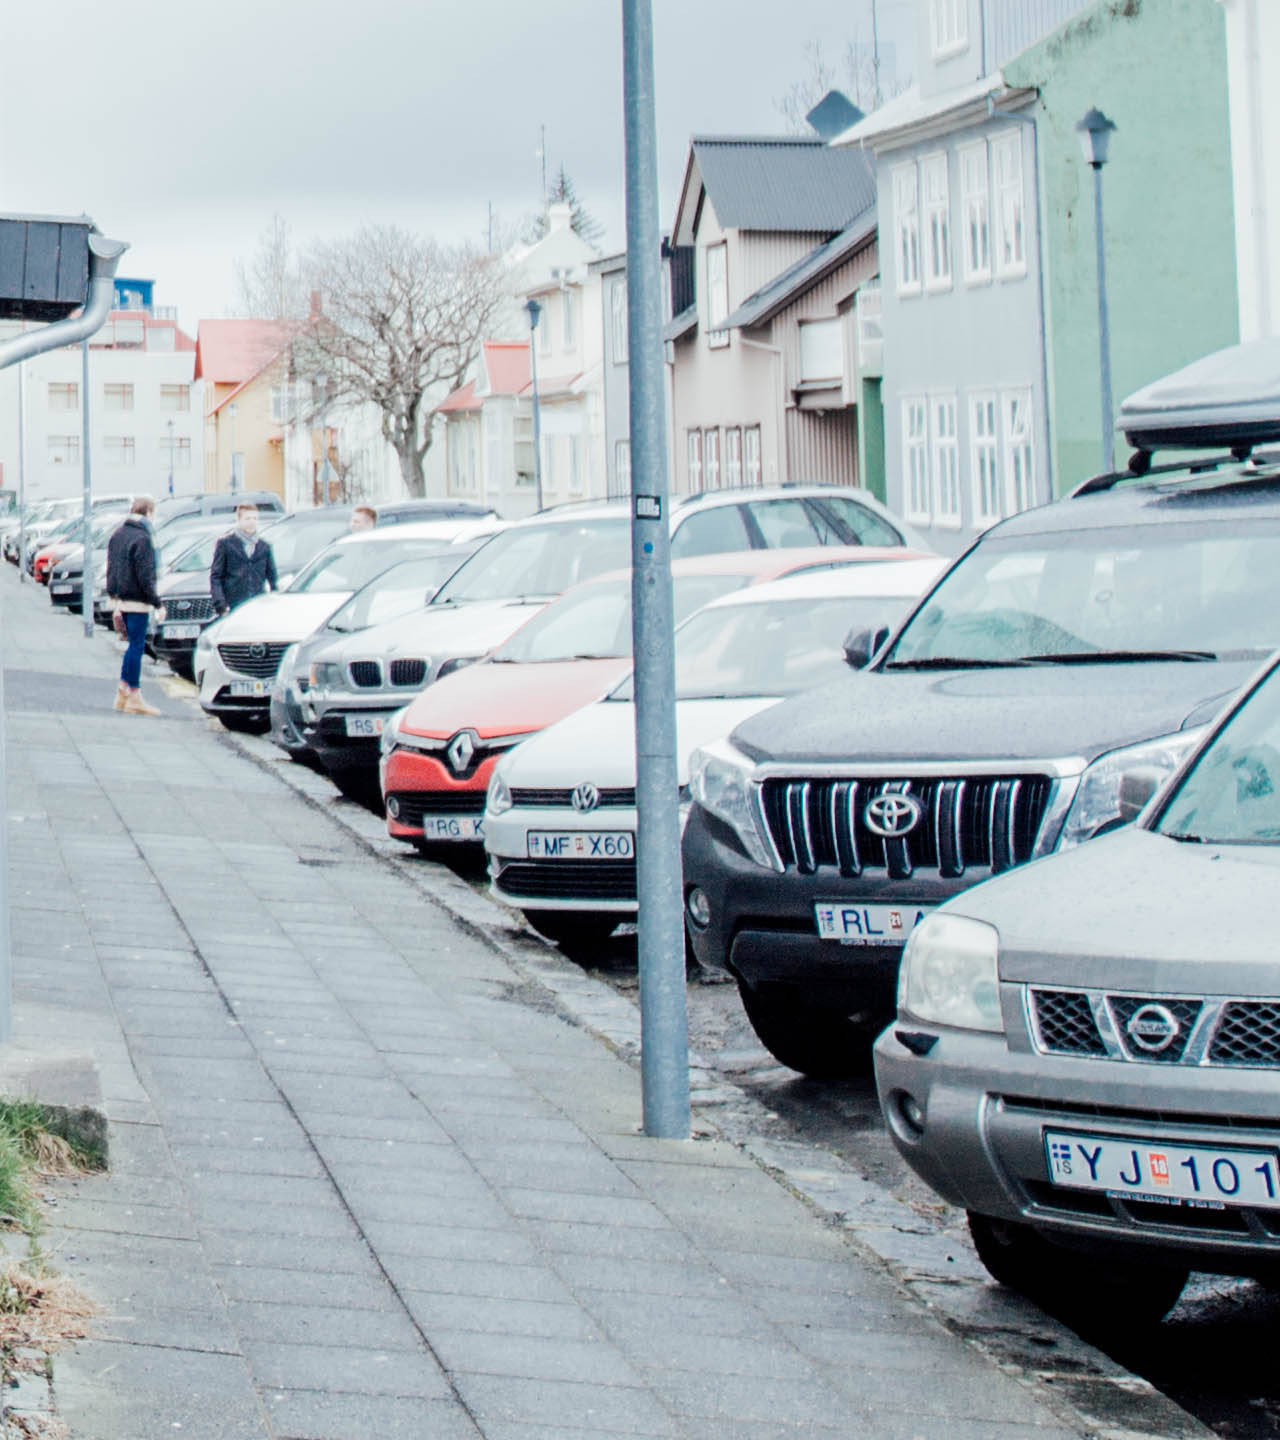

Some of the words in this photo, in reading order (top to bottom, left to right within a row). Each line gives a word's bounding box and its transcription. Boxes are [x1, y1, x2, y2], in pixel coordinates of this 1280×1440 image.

[543, 836, 570, 856] MF
[588, 835, 631, 856] X60
[840, 908, 884, 935] RL
[1180, 1155, 1276, 1199] 101
